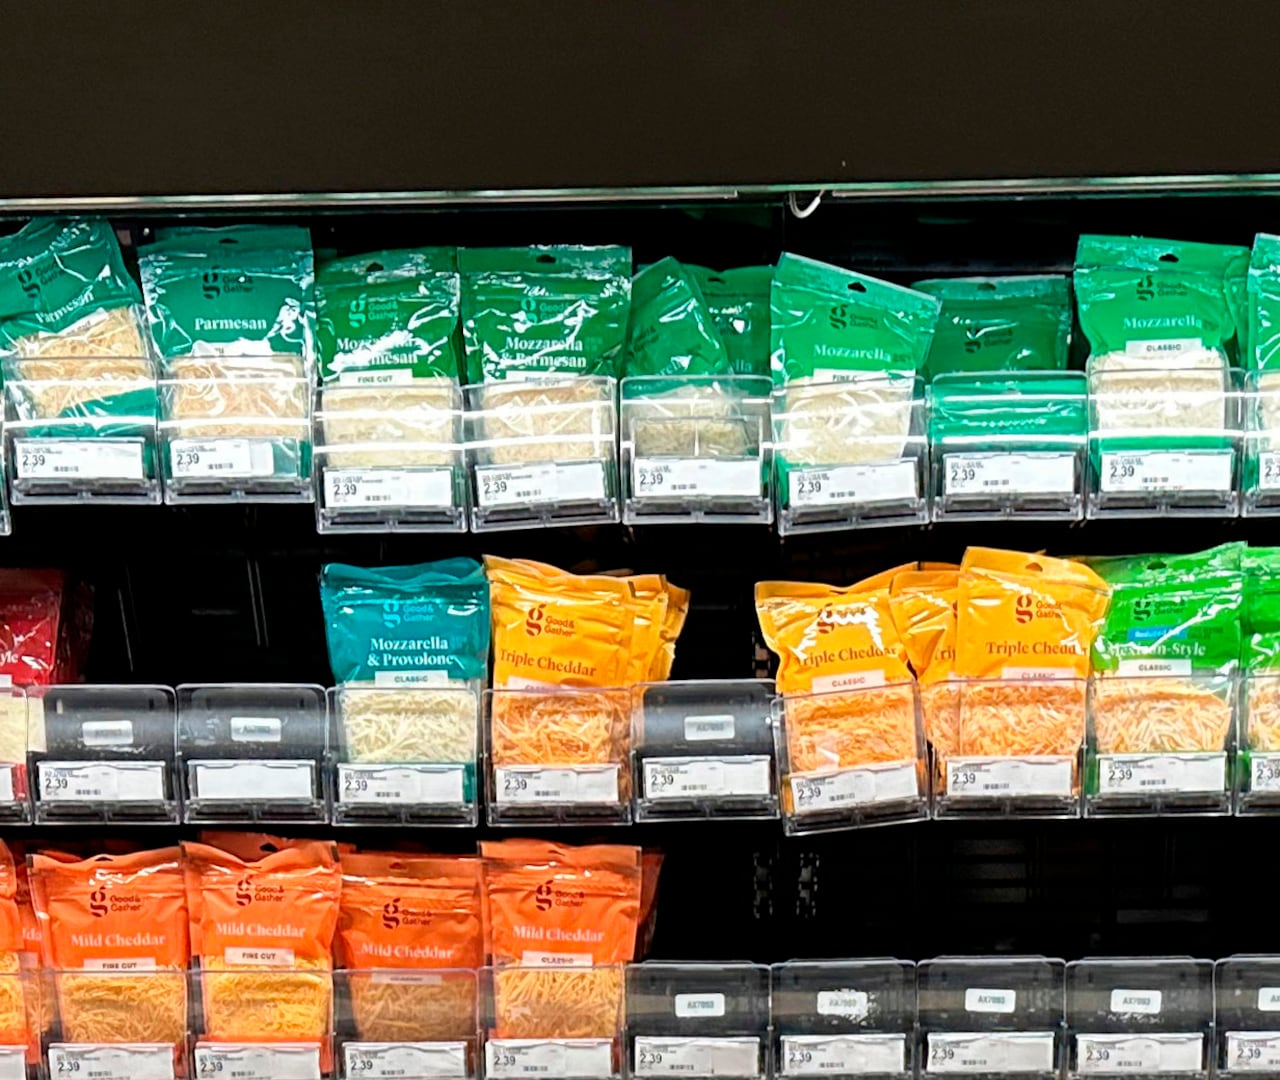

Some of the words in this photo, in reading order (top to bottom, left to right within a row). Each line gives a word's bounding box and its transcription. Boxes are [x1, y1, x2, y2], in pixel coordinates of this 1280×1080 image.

[35, 291, 94, 324] Parmesan
[194, 316, 267, 332] Parmesan
[1123, 315, 1203, 329] Mozzarella
[813, 344, 892, 363] Mozzarella
[176, 452, 199, 466] 2.39
[797, 480, 822, 494] 2.39
[370, 636, 448, 651] Mozzarella
[795, 650, 836, 666] Triple
[838, 645, 898, 661] Cheddar
[500, 650, 535, 671] Triple
[537, 656, 598, 677] Cheddar
[1138, 663, 1172, 672] CLASSIC
[832, 677, 866, 688] CLASSIC
[1256, 768, 1280, 779] 2.39
[345, 779, 368, 791] 2.39
[798, 786, 821, 800] 2.39
[216, 922, 243, 937] Mild
[246, 922, 306, 938] Cheddar
[513, 926, 542, 940] Mild
[545, 927, 605, 943] Cheddar
[71, 933, 100, 946] Mild
[103, 931, 166, 947] Cheddar
[361, 943, 389, 957] Mild
[392, 943, 453, 960] Cheddar
[639, 1052, 663, 1065] 2.39
[789, 1050, 812, 1064] 2.39
[1236, 1047, 1261, 1060] 2.39
